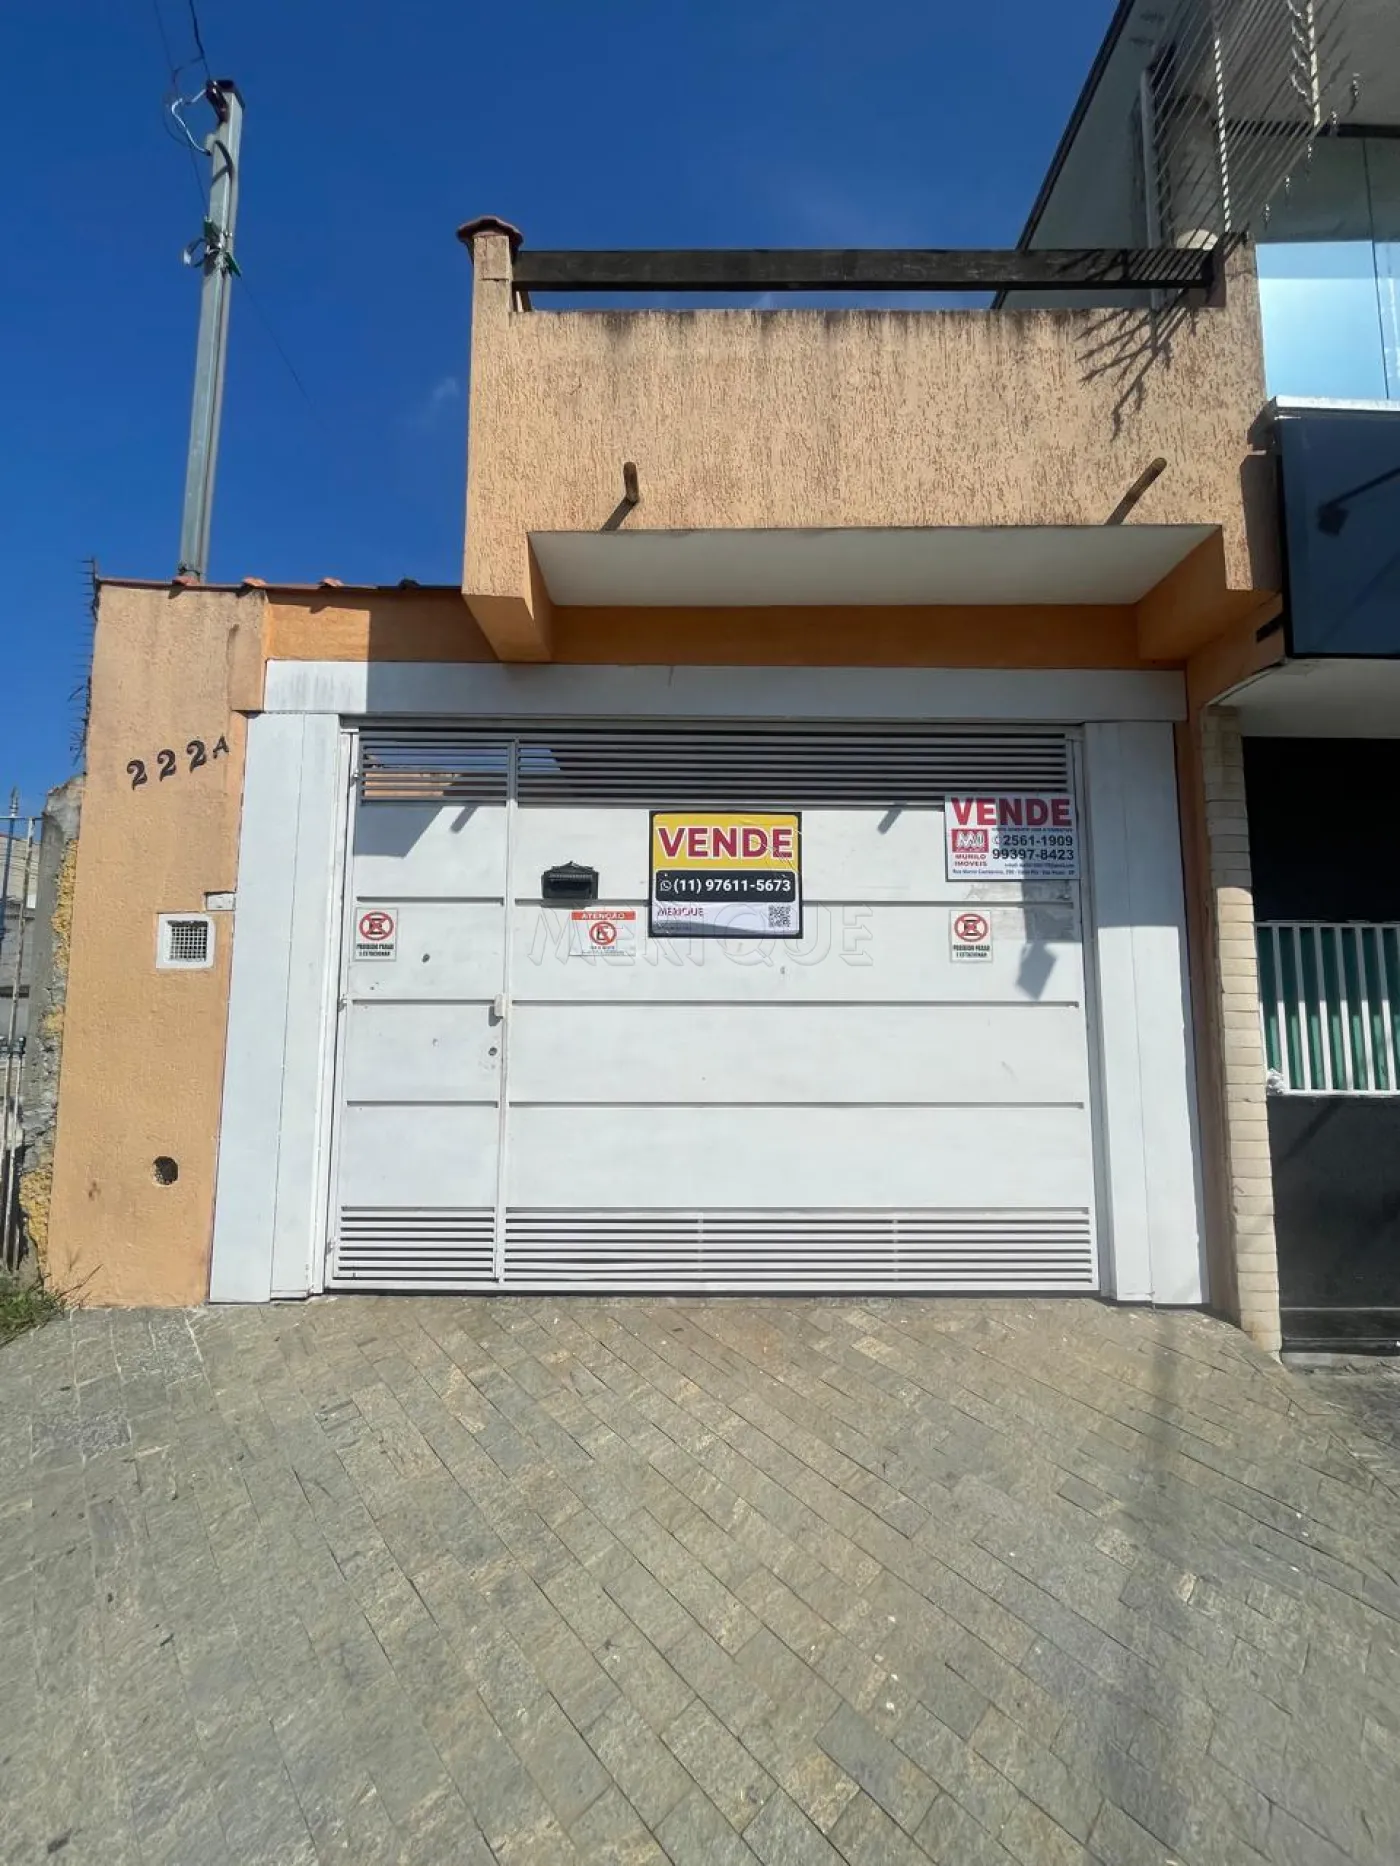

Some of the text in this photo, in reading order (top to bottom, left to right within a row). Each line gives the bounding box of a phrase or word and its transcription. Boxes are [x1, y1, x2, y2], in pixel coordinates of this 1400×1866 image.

[951, 797, 1073, 827] VENDE
[657, 826, 794, 859] VENDE
[1003, 834, 1073, 847] 2561-1909
[992, 848, 1074, 861] 99397-8423
[674, 878, 792, 894] (11) 97611-5673
